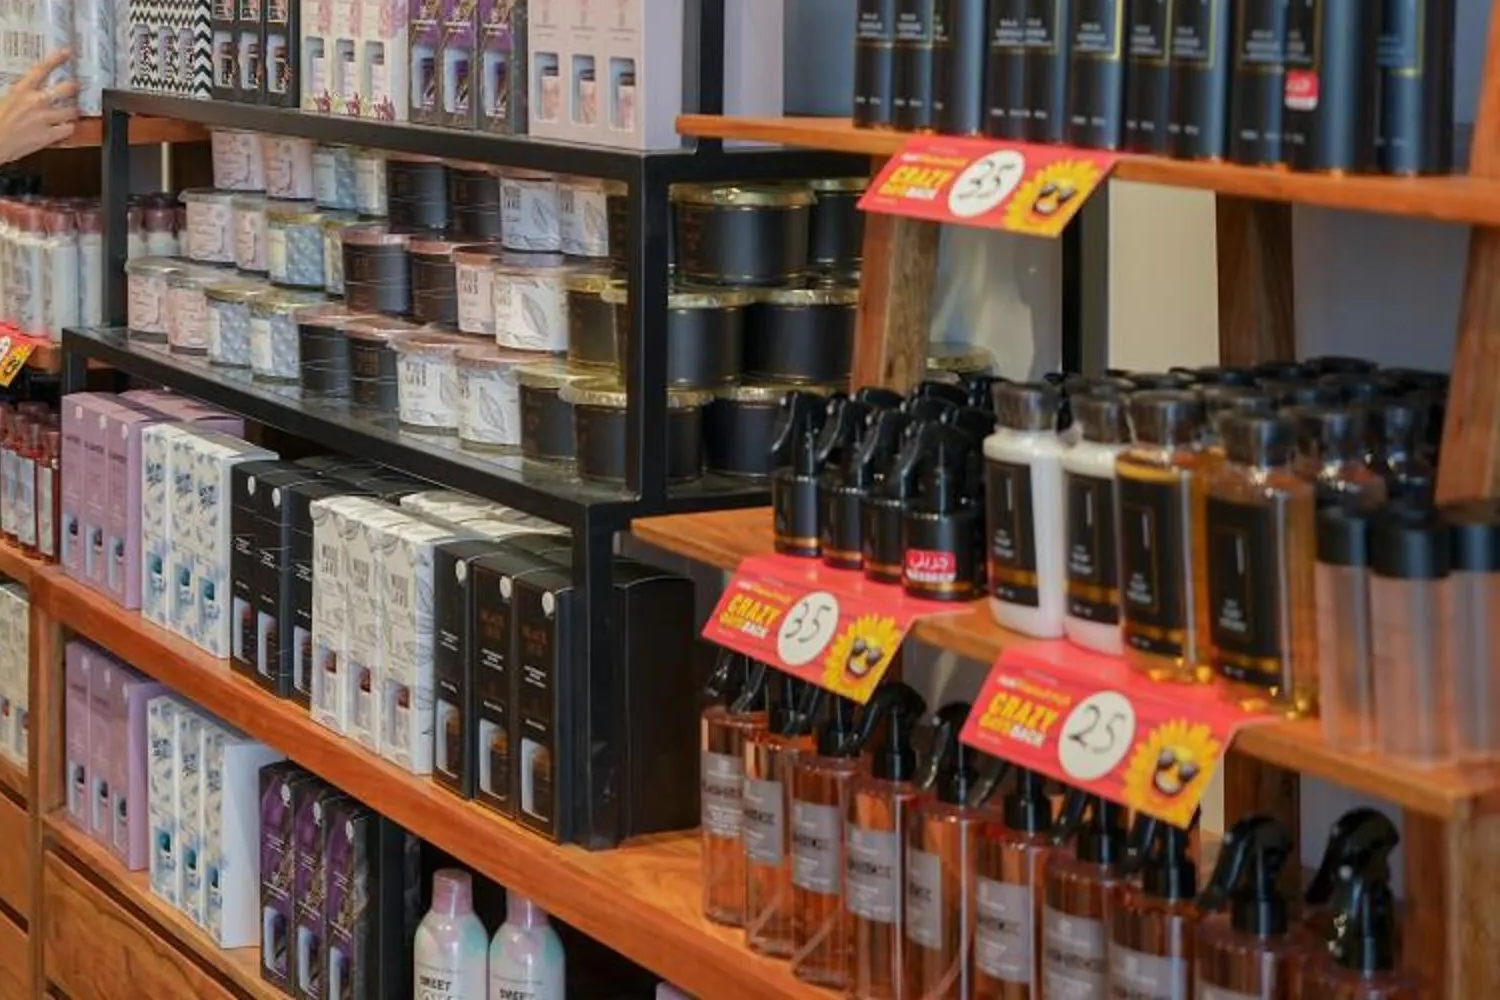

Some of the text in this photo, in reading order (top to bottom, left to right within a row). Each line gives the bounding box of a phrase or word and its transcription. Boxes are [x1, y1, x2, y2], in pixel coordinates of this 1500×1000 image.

[784, 601, 832, 643] 35
[988, 691, 1060, 730] CRAZY
[1067, 703, 1127, 754] 25
